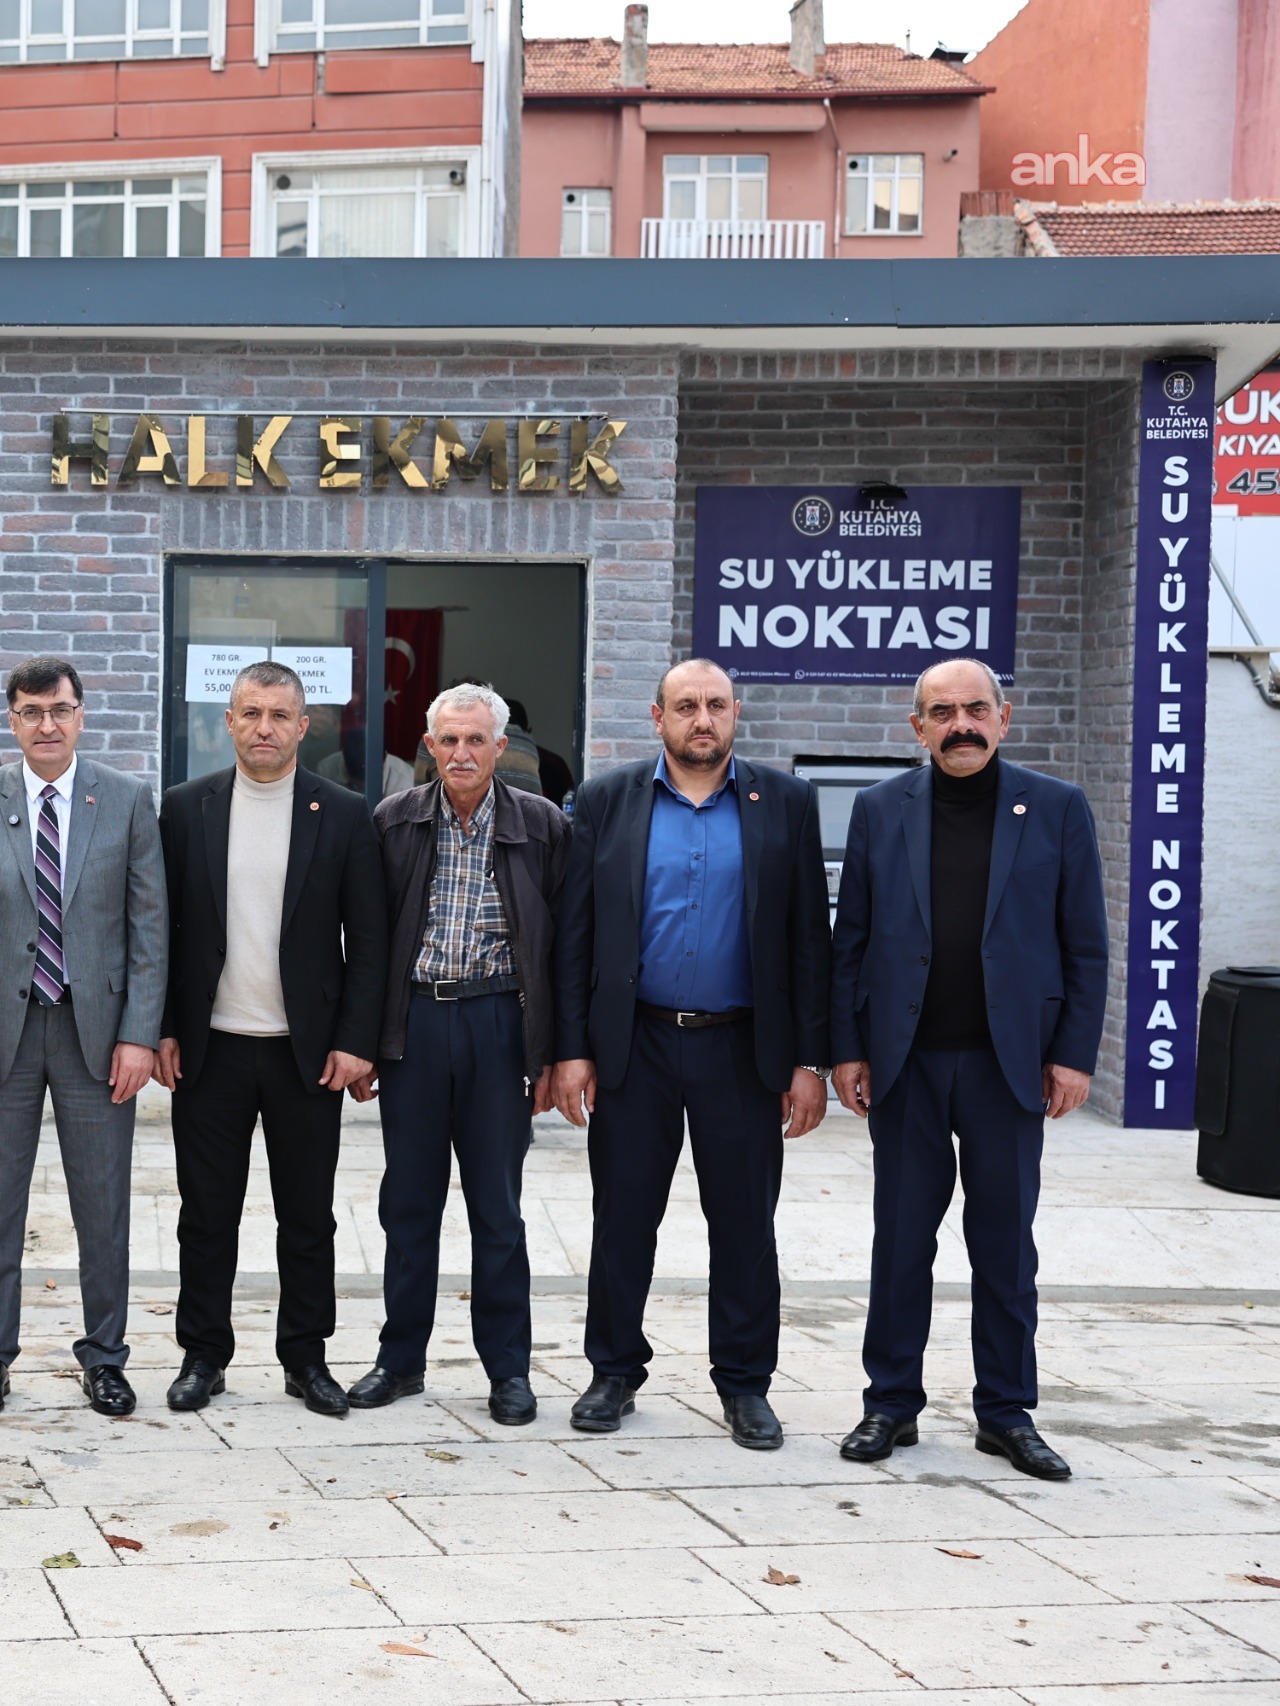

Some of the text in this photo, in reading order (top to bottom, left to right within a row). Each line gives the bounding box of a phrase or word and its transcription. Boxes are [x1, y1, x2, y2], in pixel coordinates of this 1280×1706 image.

[1168, 405, 1188, 416] T.C.
[51, 414, 628, 492] HALK EKMEK
[1226, 468, 1280, 496] 45
[839, 510, 922, 524] KÜTAHYA
[718, 549, 993, 591] SU YÜKLEME
[718, 604, 990, 650] NOKTASI
[211, 654, 242, 662] 780 GR.
[296, 656, 327, 664] 200 GR.
[204, 668, 215, 676] EV
[297, 670, 326, 678] EKMEK
[319, 685, 333, 694] TL.
[1146, 455, 1190, 1110] SU YÜKLEME NOKTASI
